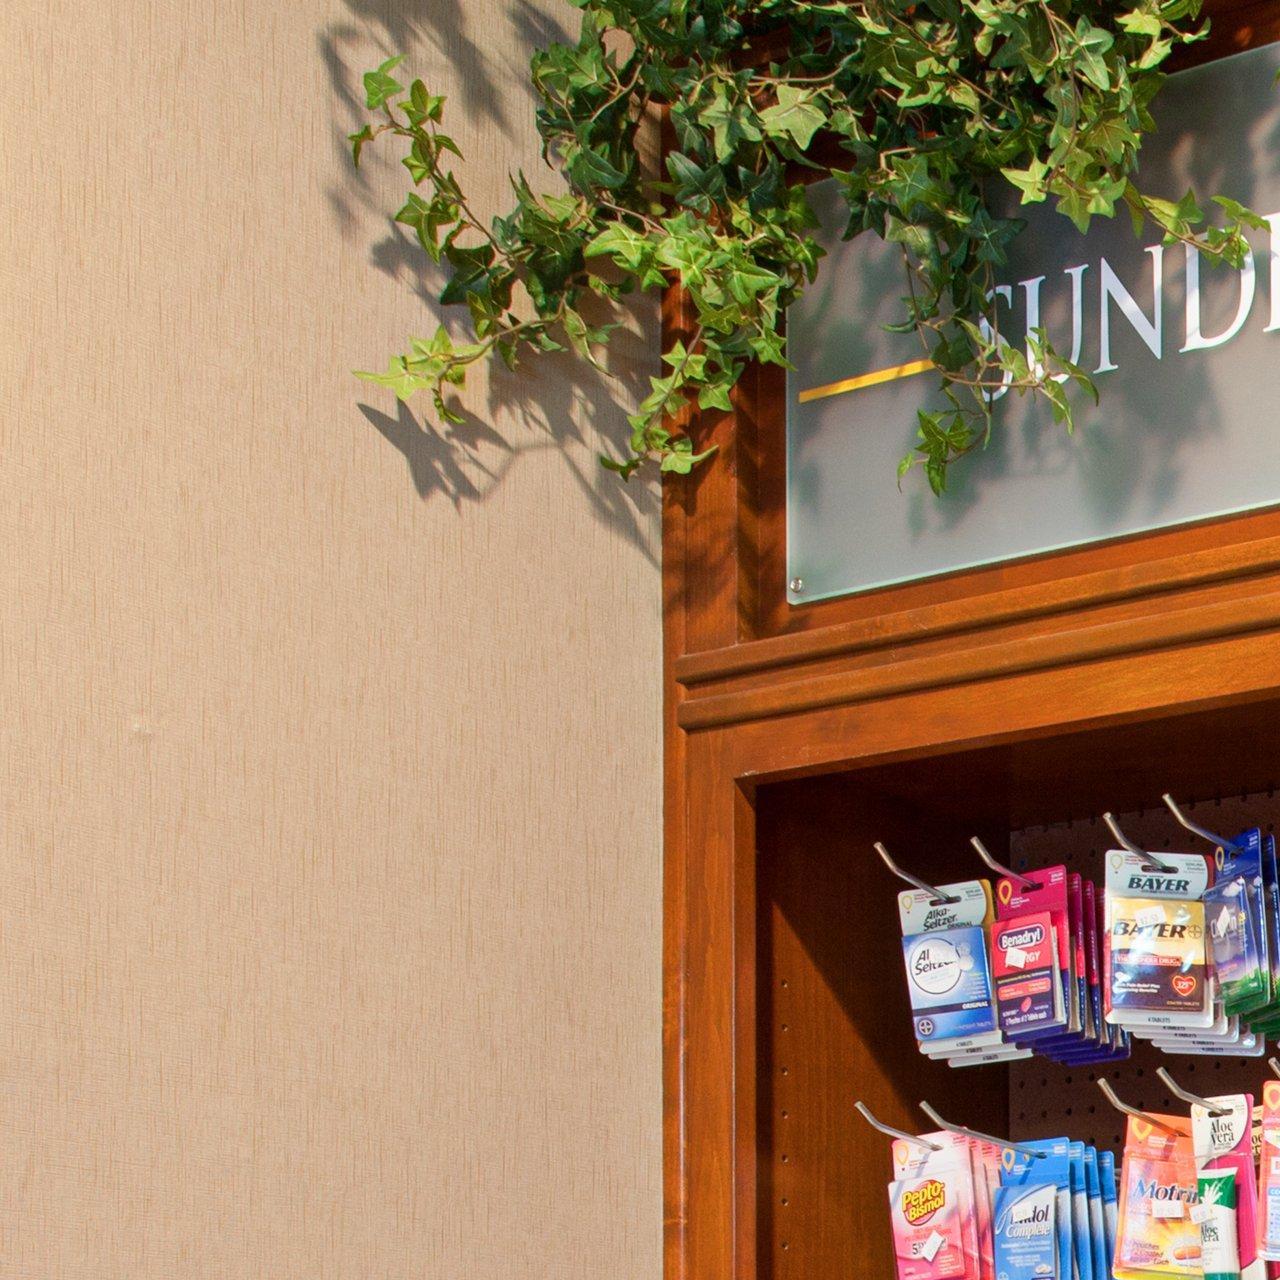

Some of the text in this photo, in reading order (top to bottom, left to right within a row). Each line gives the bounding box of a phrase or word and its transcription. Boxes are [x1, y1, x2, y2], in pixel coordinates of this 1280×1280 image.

[1128, 877, 1190, 891] BAYER
[1001, 929, 1041, 947] Benadryl
[1210, 1119, 1234, 1133] Aloe
[1210, 1131, 1235, 1145] Vera
[902, 1181, 945, 1209] Pepto-
[908, 1195, 944, 1222] Bismol
[1006, 1224, 1050, 1238] Complete
